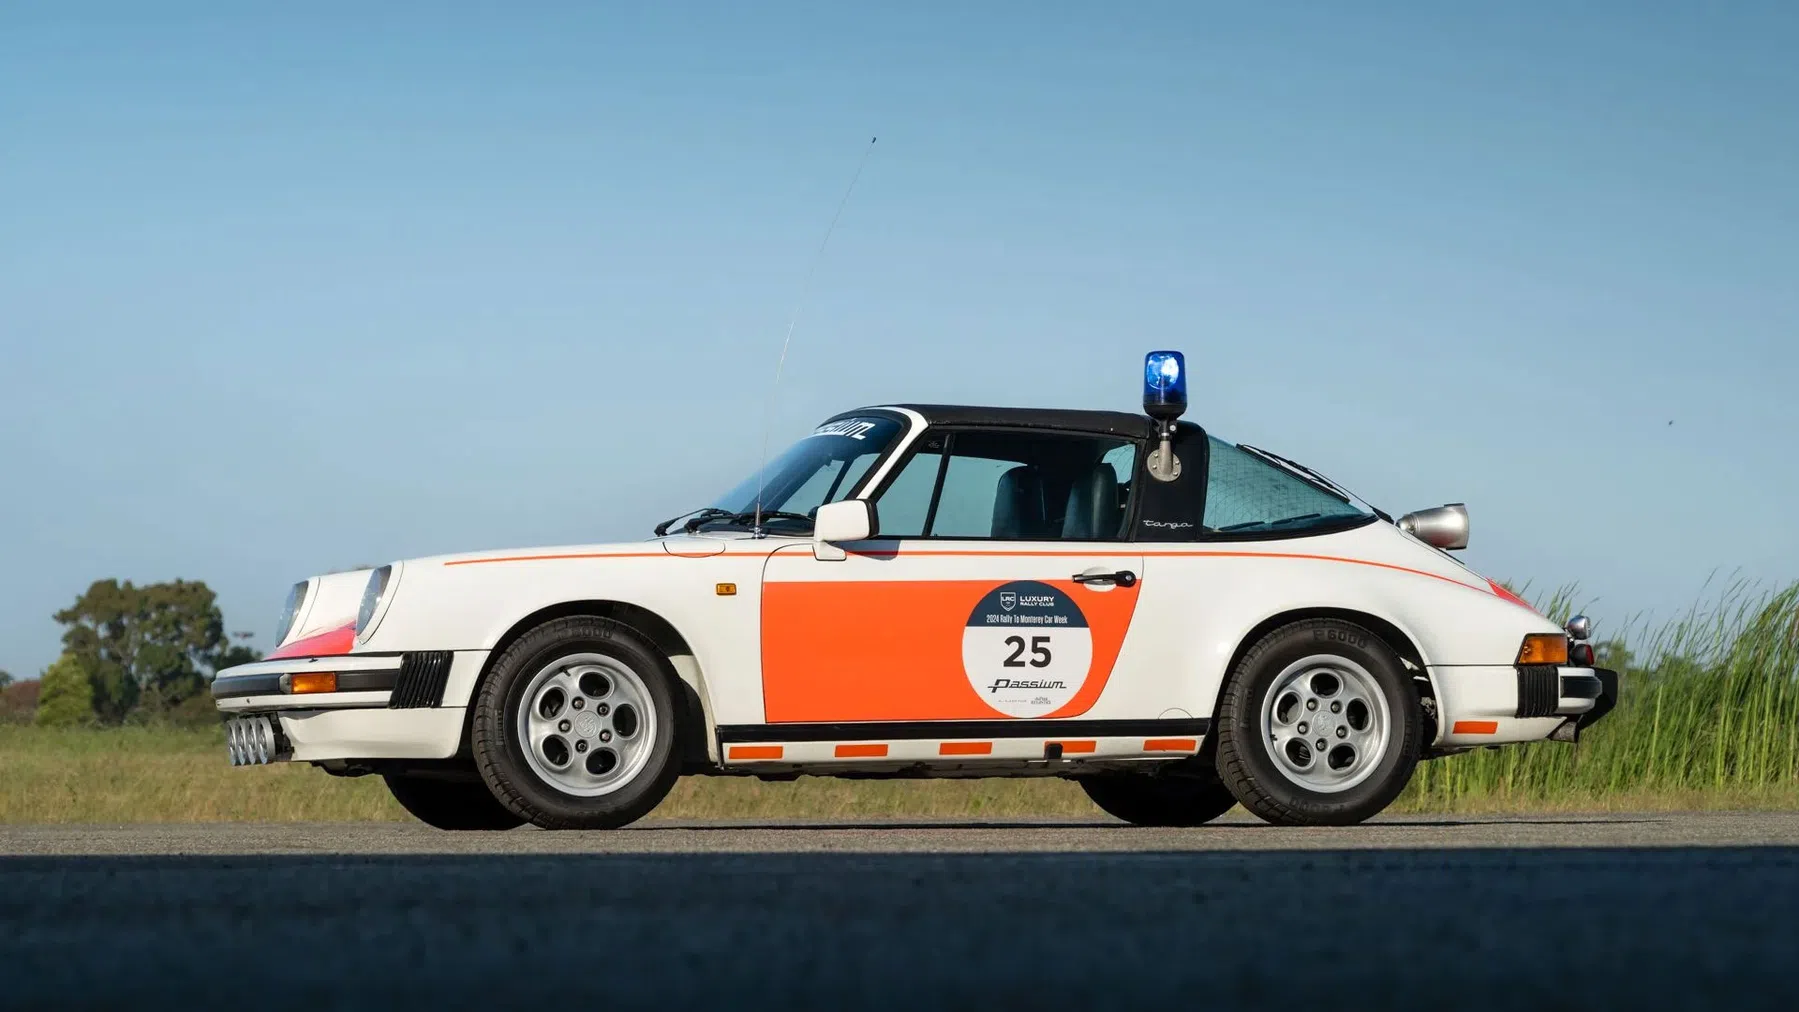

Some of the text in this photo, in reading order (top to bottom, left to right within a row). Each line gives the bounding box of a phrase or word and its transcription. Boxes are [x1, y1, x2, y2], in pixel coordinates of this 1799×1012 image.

[1143, 520, 1193, 529] targa
[986, 614, 1068, 624] 2024 Rally To Monterey Car Week
[1003, 635, 1052, 668] 25
[987, 679, 1067, 693] Passium
